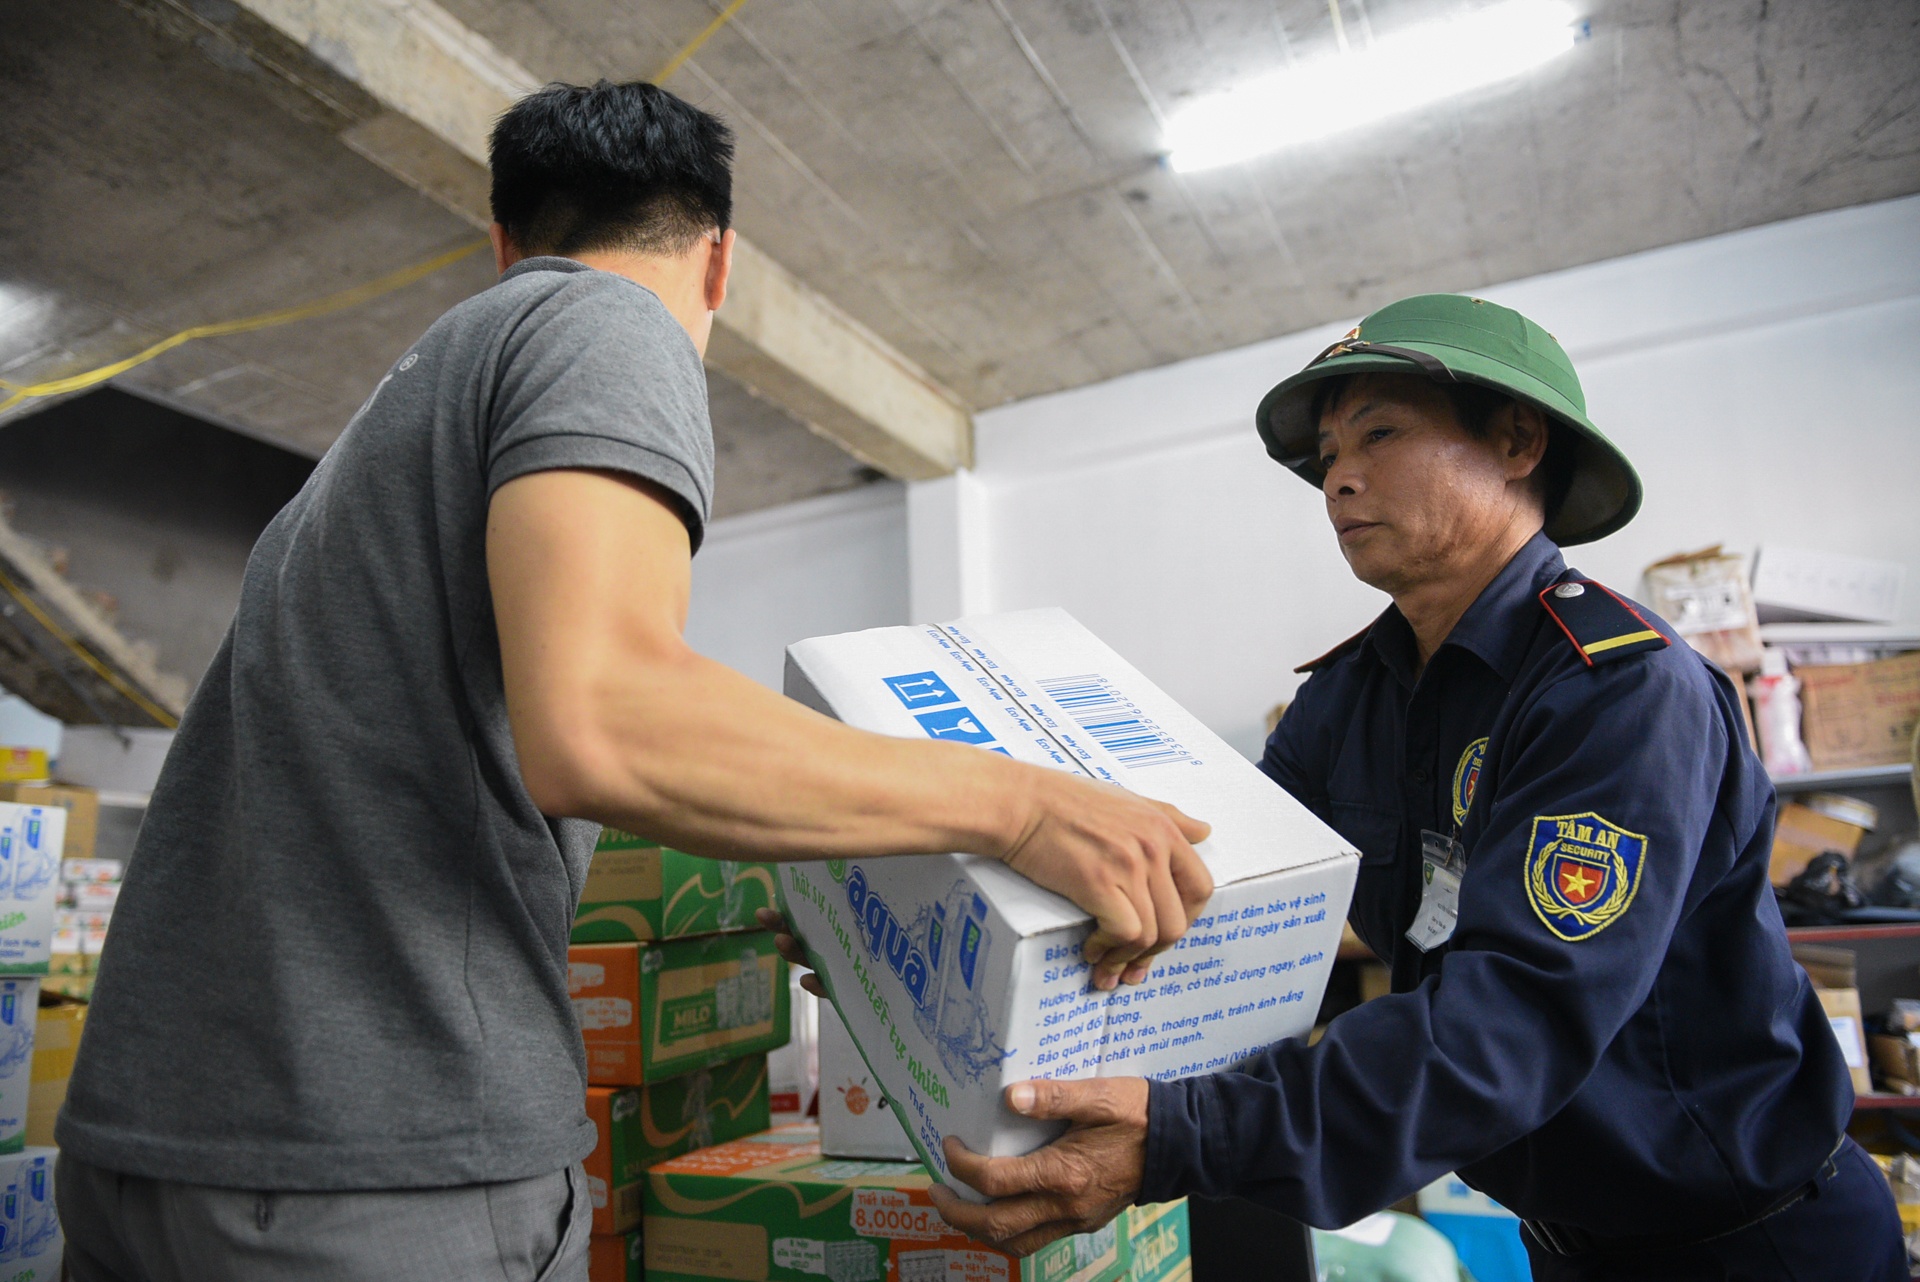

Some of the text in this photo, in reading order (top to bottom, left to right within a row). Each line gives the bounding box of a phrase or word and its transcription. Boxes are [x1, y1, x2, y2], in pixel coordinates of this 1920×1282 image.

[959, 635, 972, 644] Eco
[972, 648, 988, 660] Aqua
[986, 659, 999, 669] Eco
[1000, 674, 1017, 688] Aqua
[1014, 686, 1028, 698] Eco
[949, 651, 963, 661] Eco
[960, 660, 975, 672] Aqua
[976, 677, 990, 688] Eco
[986, 687, 1004, 701] Aqua
[1004, 706, 1019, 718] Eco
[1016, 717, 1033, 732] Aqua
[1035, 738, 1051, 750] Eco
[1047, 749, 1066, 764] Aqua
[1029, 703, 1046, 717] Aqua
[1043, 716, 1059, 729] Eco
[1060, 734, 1079, 749] Aqua
[1076, 748, 1092, 760] Eco
[1556, 820, 1621, 850] TÂM AN
[1560, 843, 1610, 864] SECURITY
[847, 865, 929, 1011] aqua
[1045, 945, 1069, 962] Bảo
[1217, 910, 1239, 925] mát
[1241, 904, 1265, 921] đảm
[1267, 899, 1287, 915] bảo
[1289, 896, 1302, 910] vệ
[1303, 891, 1326, 906] sinh
[1043, 909, 1326, 983] Sử dụng 12 tháng kể từ ngày sản xuất
[1039, 989, 1076, 1010] Hướng
[1152, 966, 1165, 979] và
[1168, 962, 1190, 977] bảo
[1192, 957, 1225, 974] quản:
[1043, 1012, 1065, 1028] Sản
[1067, 998, 1098, 1022] phẩm
[1101, 992, 1131, 1010] uống
[1134, 989, 1157, 1003] trực
[1159, 981, 1184, 997] tiếp,
[1186, 979, 1201, 991] có
[1203, 971, 1224, 988] thể
[1223, 969, 1239, 984] sử
[1239, 965, 1267, 981] dụng
[1268, 960, 1296, 975] ngay,
[1299, 951, 1324, 967] dành
[674, 1005, 711, 1030] MILO
[1037, 1049, 1060, 1066] Bảo
[1062, 1039, 1089, 1059] quản
[1092, 1034, 1110, 1049] nơi
[1112, 1028, 1135, 1043] khô
[1137, 1025, 1158, 1038] ráo,
[1161, 1015, 1199, 1033] thoáng
[1202, 1009, 1225, 1023] mát,
[1228, 1001, 1255, 1017] tránh
[1257, 997, 1277, 1010] ánh
[1279, 989, 1304, 1004] nắng
[1039, 1011, 1143, 1047] cho mọi đối tượng.
[1055, 1061, 1079, 1078] tiếp,
[1082, 1055, 1102, 1070] hóa
[1105, 1047, 1131, 1063] chất
[1133, 1044, 1146, 1056] và
[1148, 1038, 1169, 1053] mùi
[1172, 1030, 1205, 1047] mạnh.
[1156, 1068, 1177, 1081] trên
[1180, 1062, 1204, 1075] thân
[1206, 1054, 1228, 1069] chai
[1229, 1048, 1248, 1064] (Vỏ
[907, 1055, 950, 1110] nhiên
[908, 1085, 925, 1118] Thể
[920, 1125, 946, 1174] 500ml
[857, 1191, 905, 1211] Tiết kiệm
[1043, 1245, 1071, 1280] MILO
